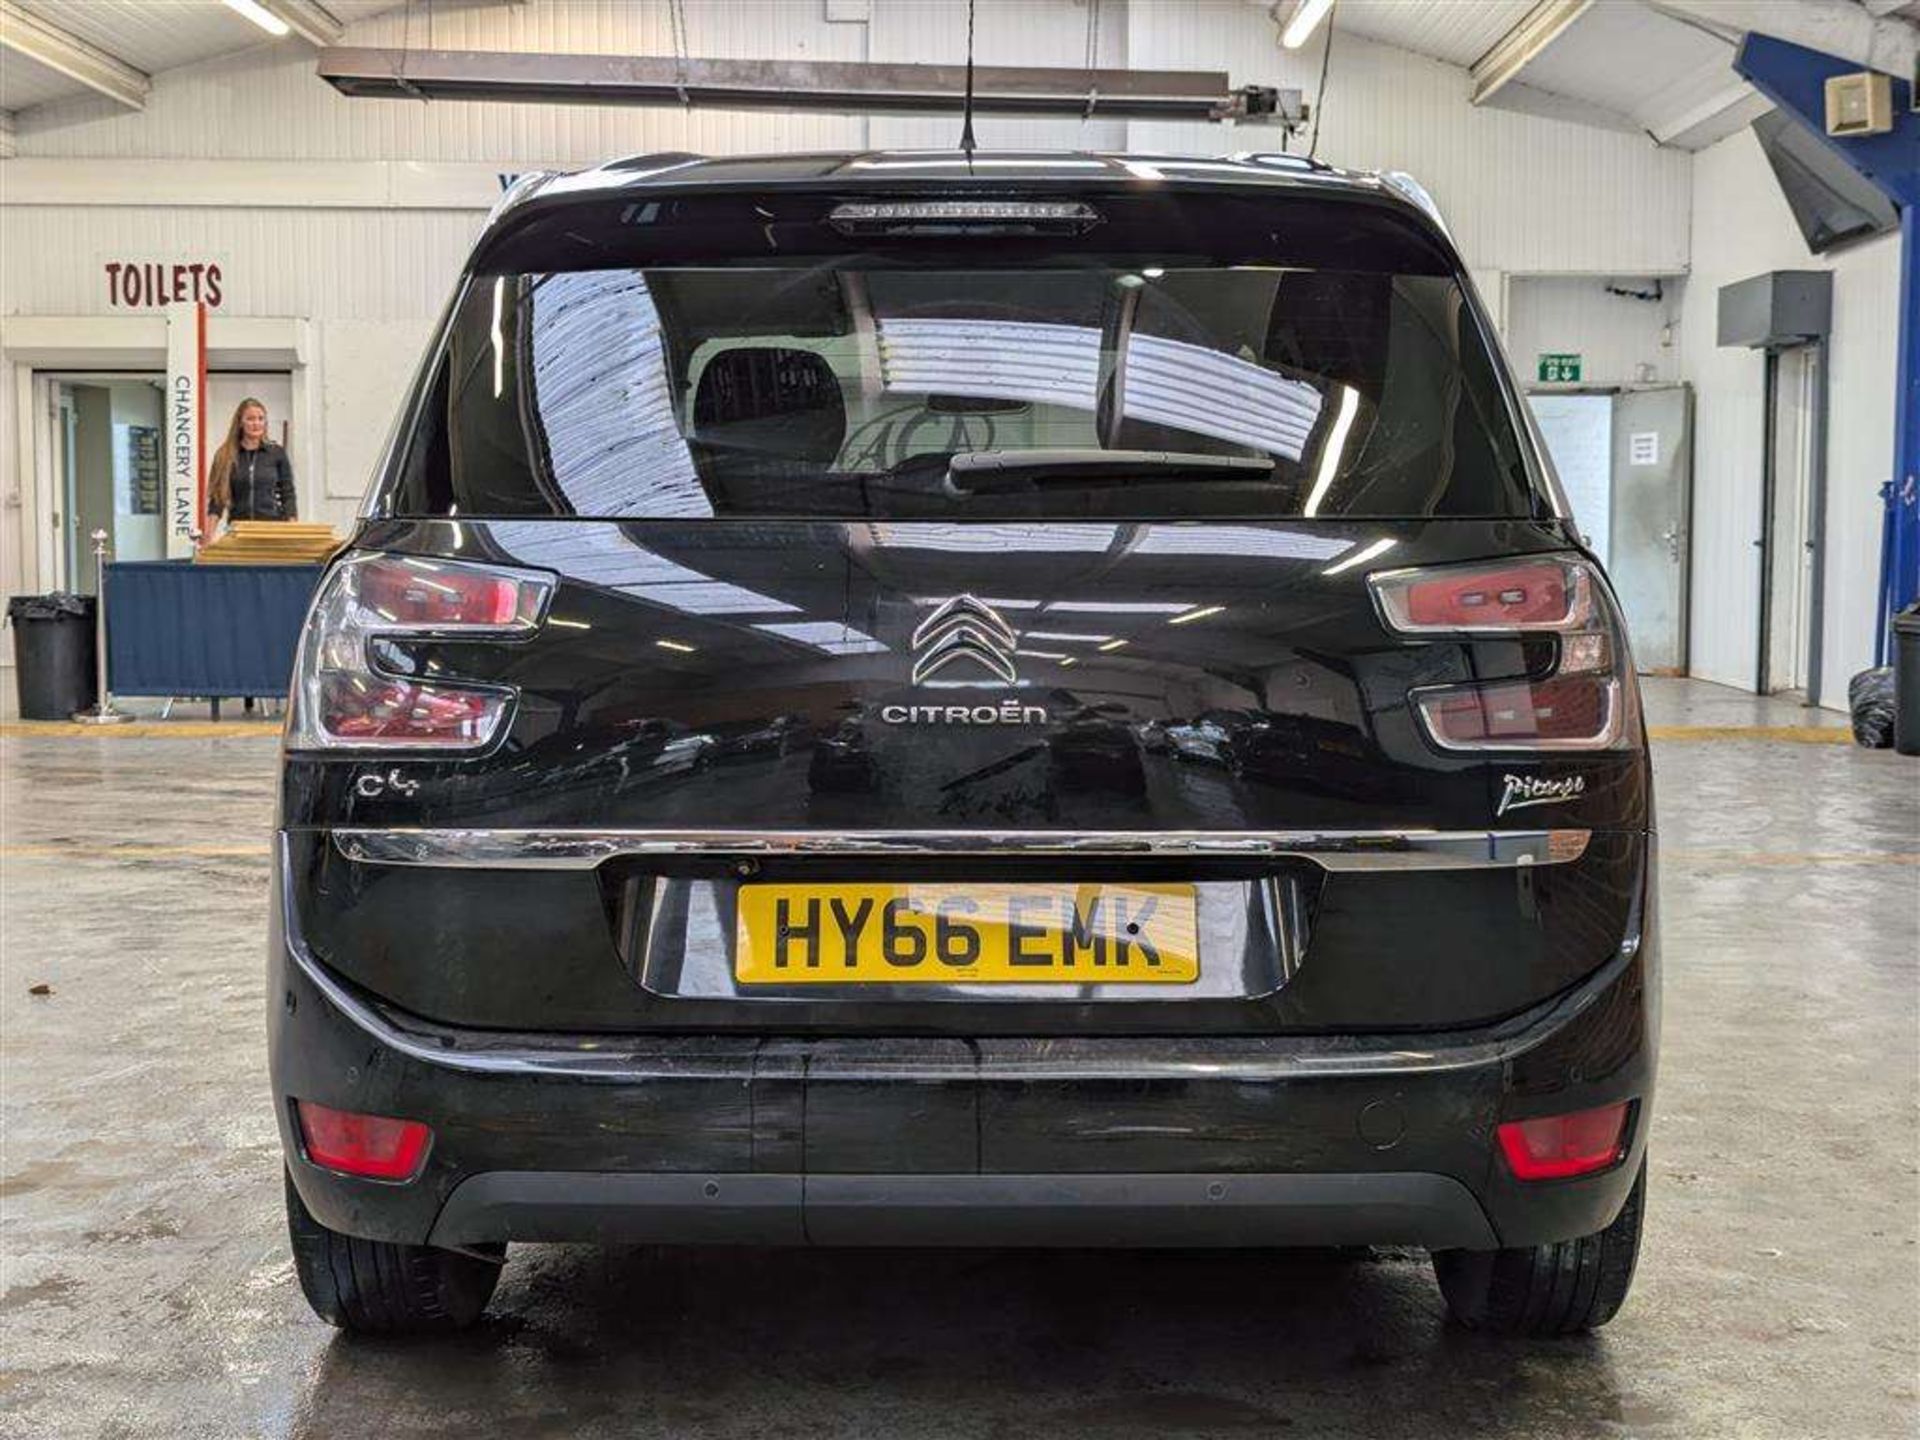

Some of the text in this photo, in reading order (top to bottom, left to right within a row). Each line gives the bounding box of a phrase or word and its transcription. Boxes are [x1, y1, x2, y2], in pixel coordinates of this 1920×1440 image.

[105, 263, 222, 307] TOILETS
[175, 376, 191, 537] CHANCERY LANE
[775, 897, 1161, 968] HY66 EMK
